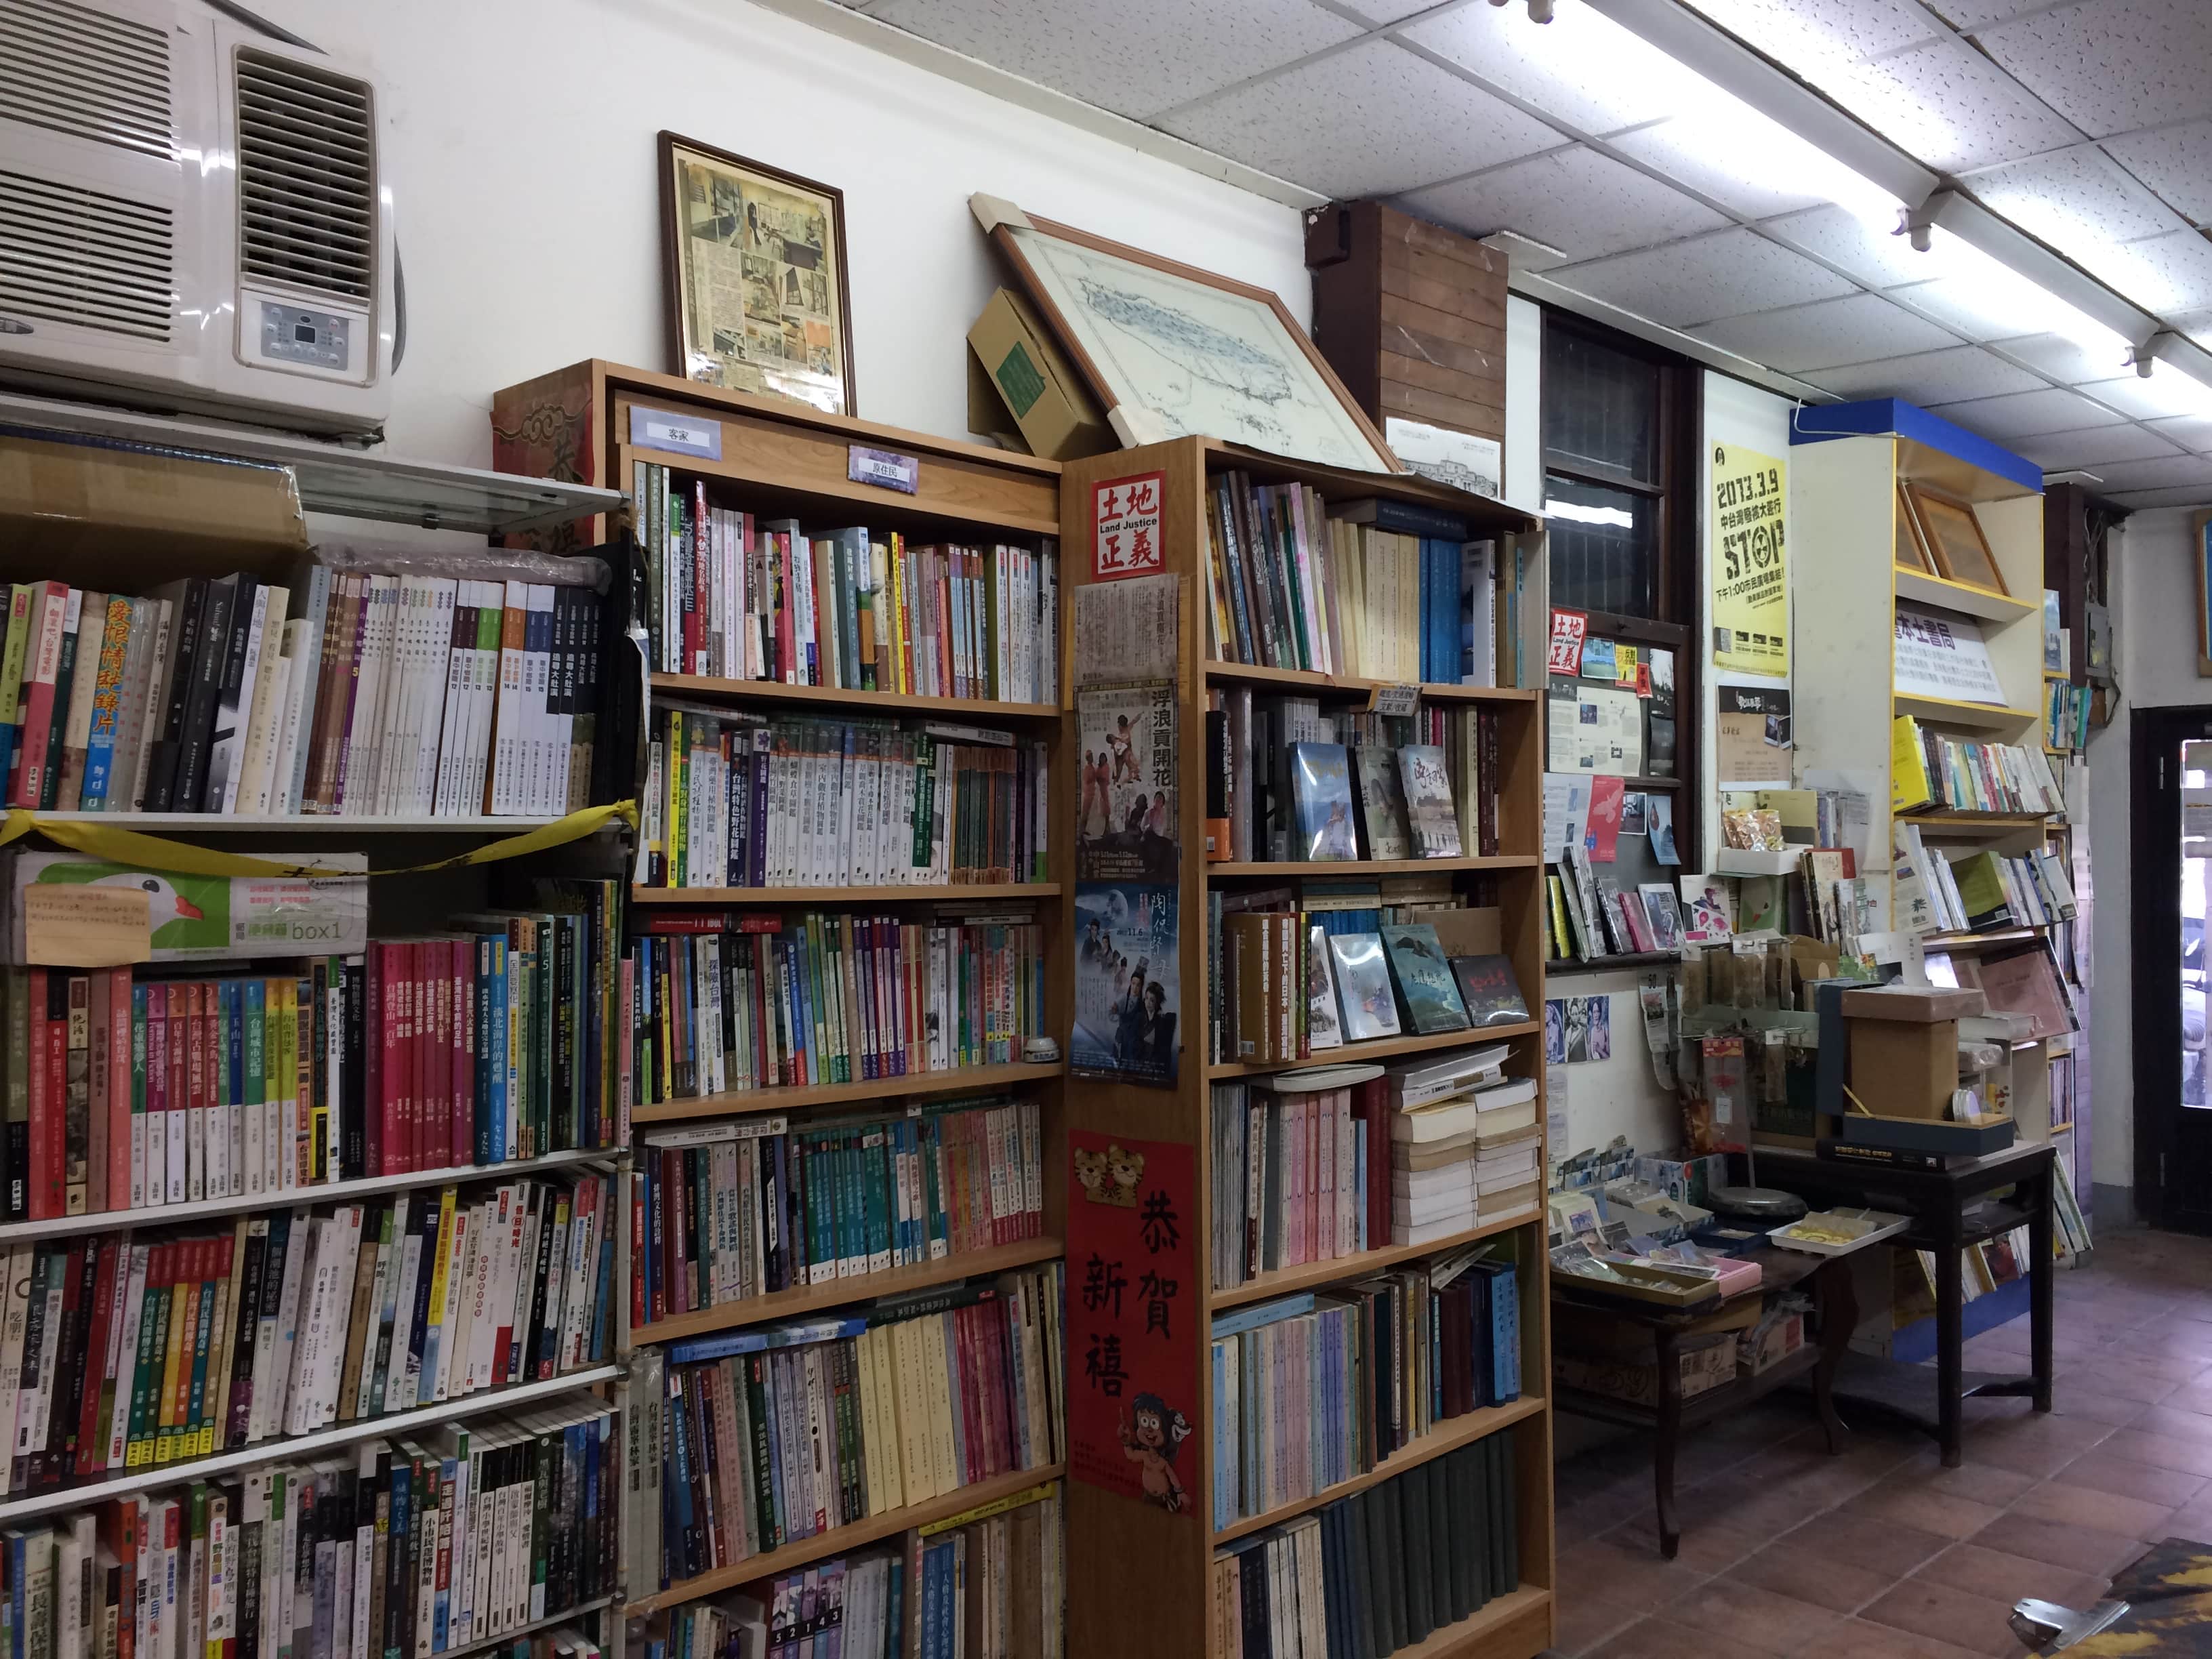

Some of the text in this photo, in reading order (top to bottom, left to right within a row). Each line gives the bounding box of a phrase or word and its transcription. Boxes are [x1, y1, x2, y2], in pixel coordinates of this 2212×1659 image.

[668, 428, 689, 442] 客家
[872, 463, 898, 478] 原住民
[1717, 468, 1779, 509] 2013.3.9
[1099, 483, 1158, 524] 土地
[1100, 518, 1157, 534] Land Justice
[1101, 528, 1159, 570] 正義
[1723, 519, 1784, 580] STOP
[1554, 616, 1582, 638] 土地
[1549, 645, 1576, 670] 正義
[352, 667, 359, 676] 5
[1152, 690, 1172, 787] 浮浪貢開花
[292, 922, 342, 939] box1
[542, 960, 549, 970] 5
[1138, 1190, 1181, 1340] 恭賀
[1082, 1252, 1128, 1397] 新禧
[819, 1617, 825, 1626] 4
[833, 1611, 838, 1620] 3
[790, 1627, 796, 1637] 2
[806, 1623, 810, 1633] 1
[776, 1633, 781, 1643] 5
